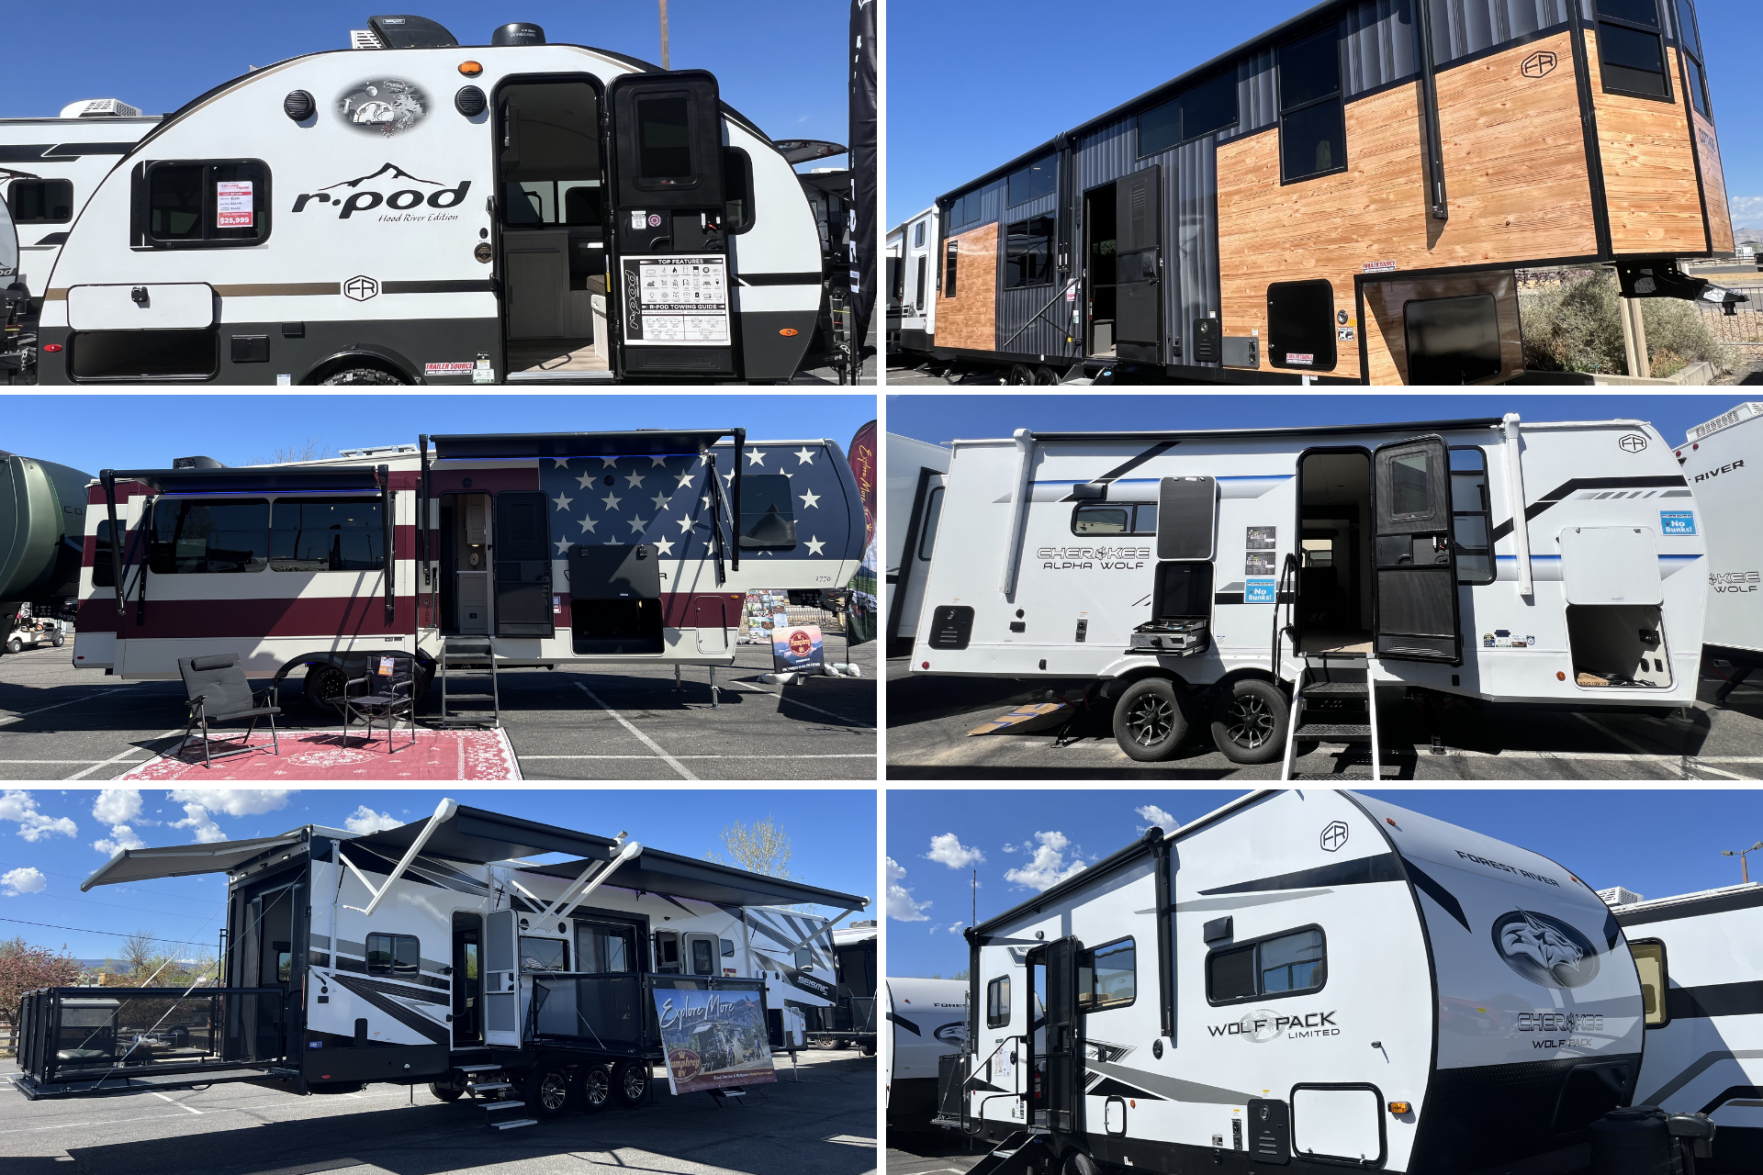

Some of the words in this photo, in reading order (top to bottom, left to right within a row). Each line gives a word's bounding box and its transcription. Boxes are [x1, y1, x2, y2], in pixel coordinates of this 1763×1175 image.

[378, 214, 401, 222] Hood
[403, 214, 426, 222] River
[428, 213, 458, 222] Edition
[1694, 460, 1745, 484] RIVER
[1454, 850, 1518, 874] FOREST
[1519, 869, 1560, 888] RIVER
[798, 976, 828, 992] SEISMIC
[660, 996, 703, 1030] Explore
[704, 994, 735, 1020] More
[1207, 1019, 1268, 1037] WOLF
[1275, 1010, 1337, 1030] PACK
[1288, 1028, 1340, 1039] LIMITED
[1532, 1040, 1566, 1048] WOLF
[1568, 1038, 1592, 1047] PACK
